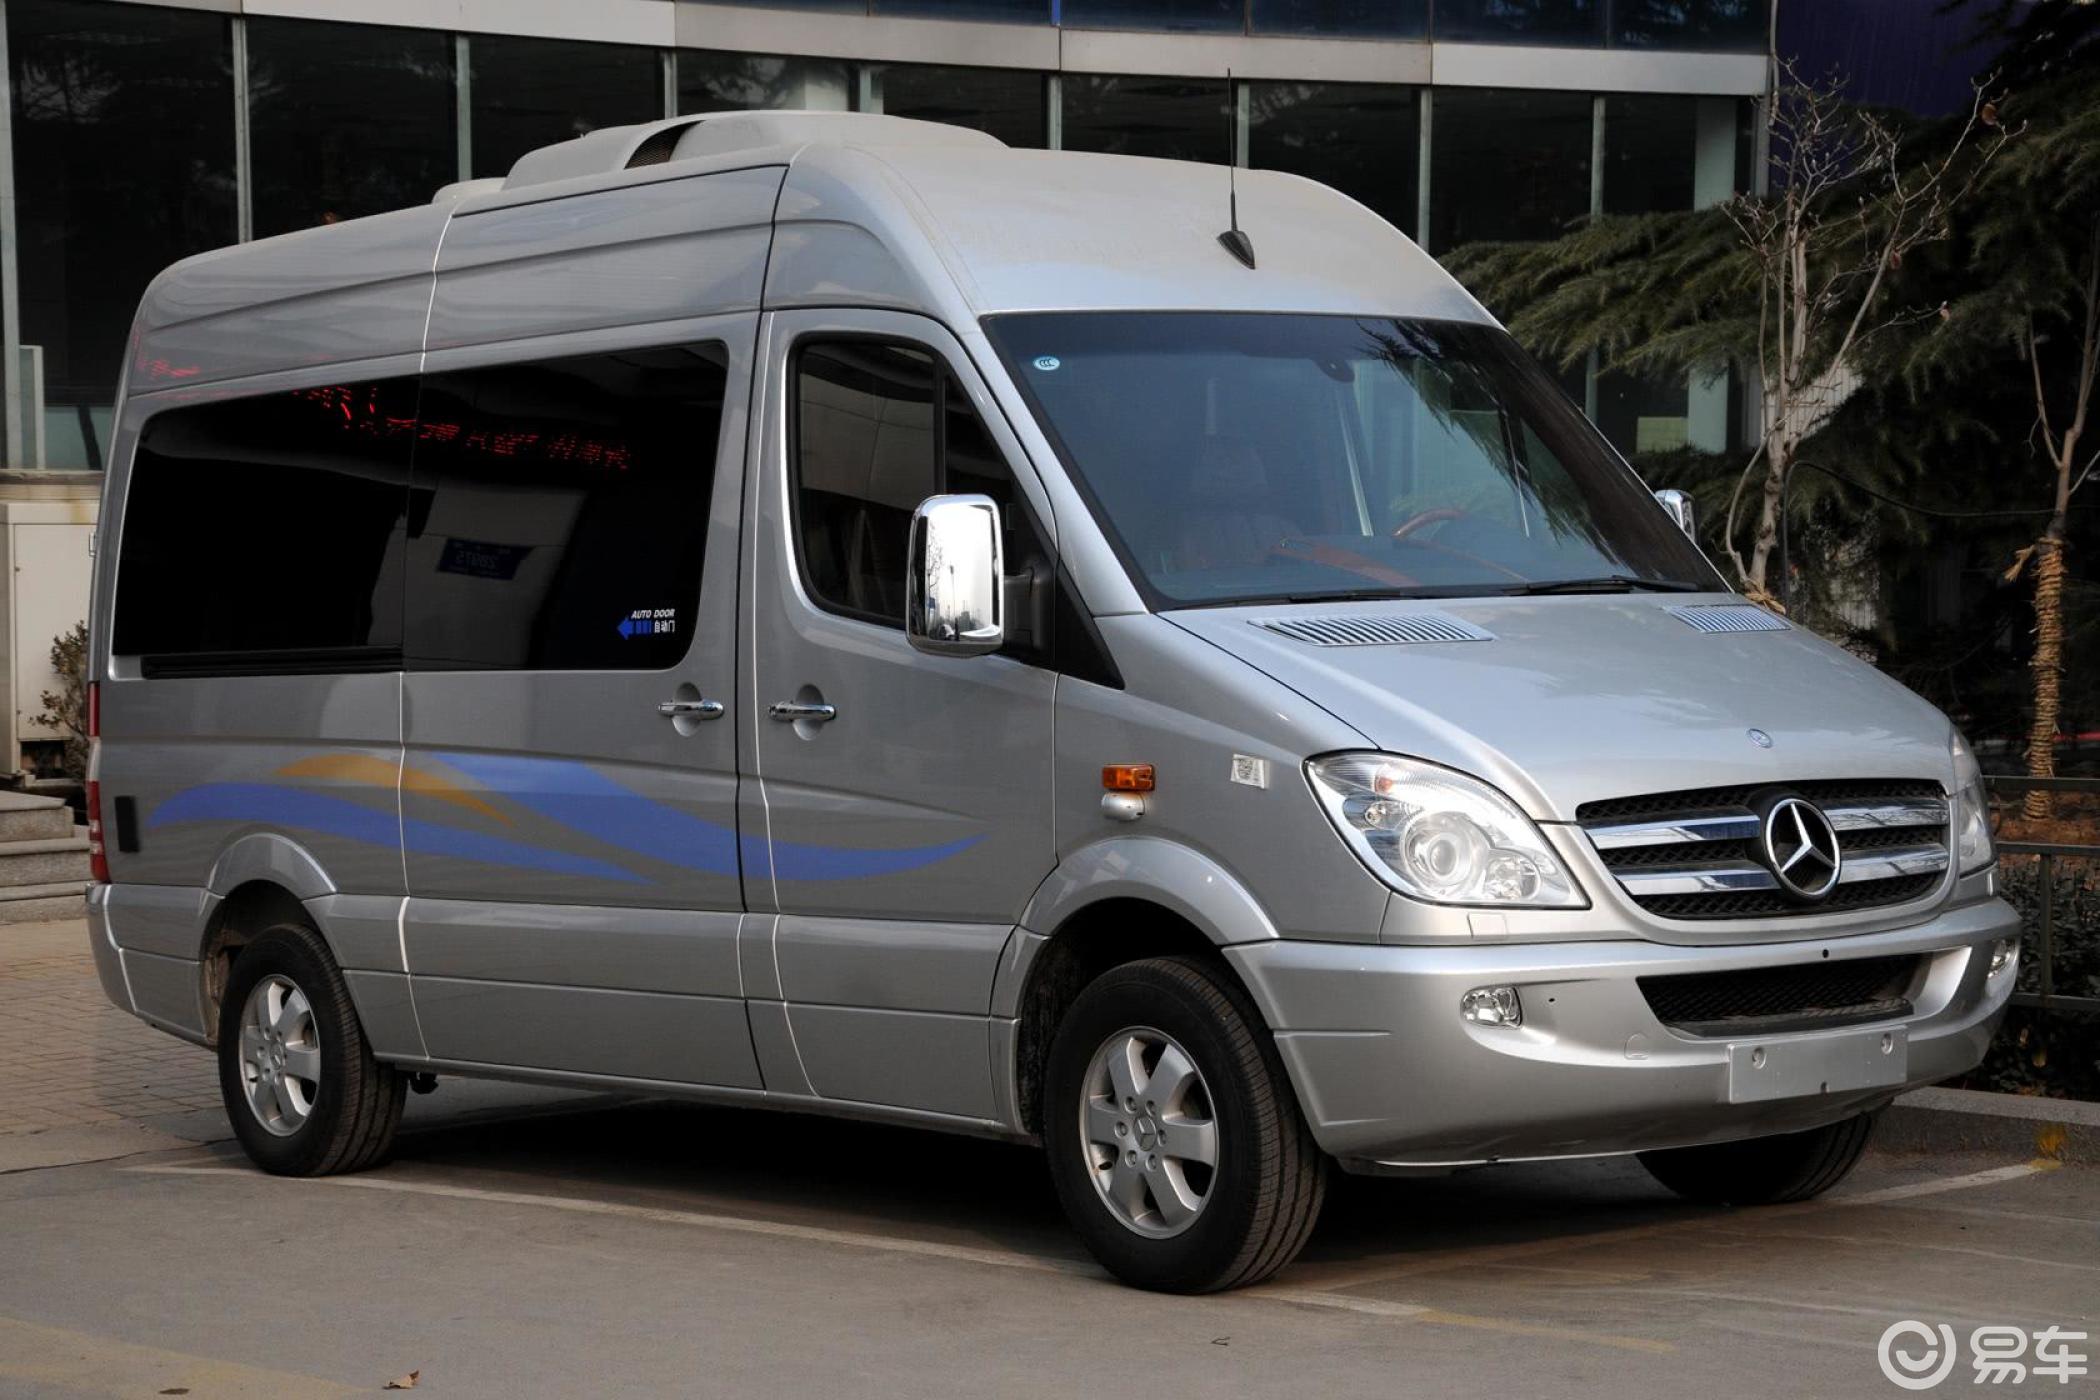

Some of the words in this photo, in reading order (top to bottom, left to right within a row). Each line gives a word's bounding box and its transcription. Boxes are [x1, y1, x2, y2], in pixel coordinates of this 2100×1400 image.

[631, 609, 652, 619] AUTO
[654, 608, 676, 618] DOOR
[654, 620, 675, 633] 自动门
